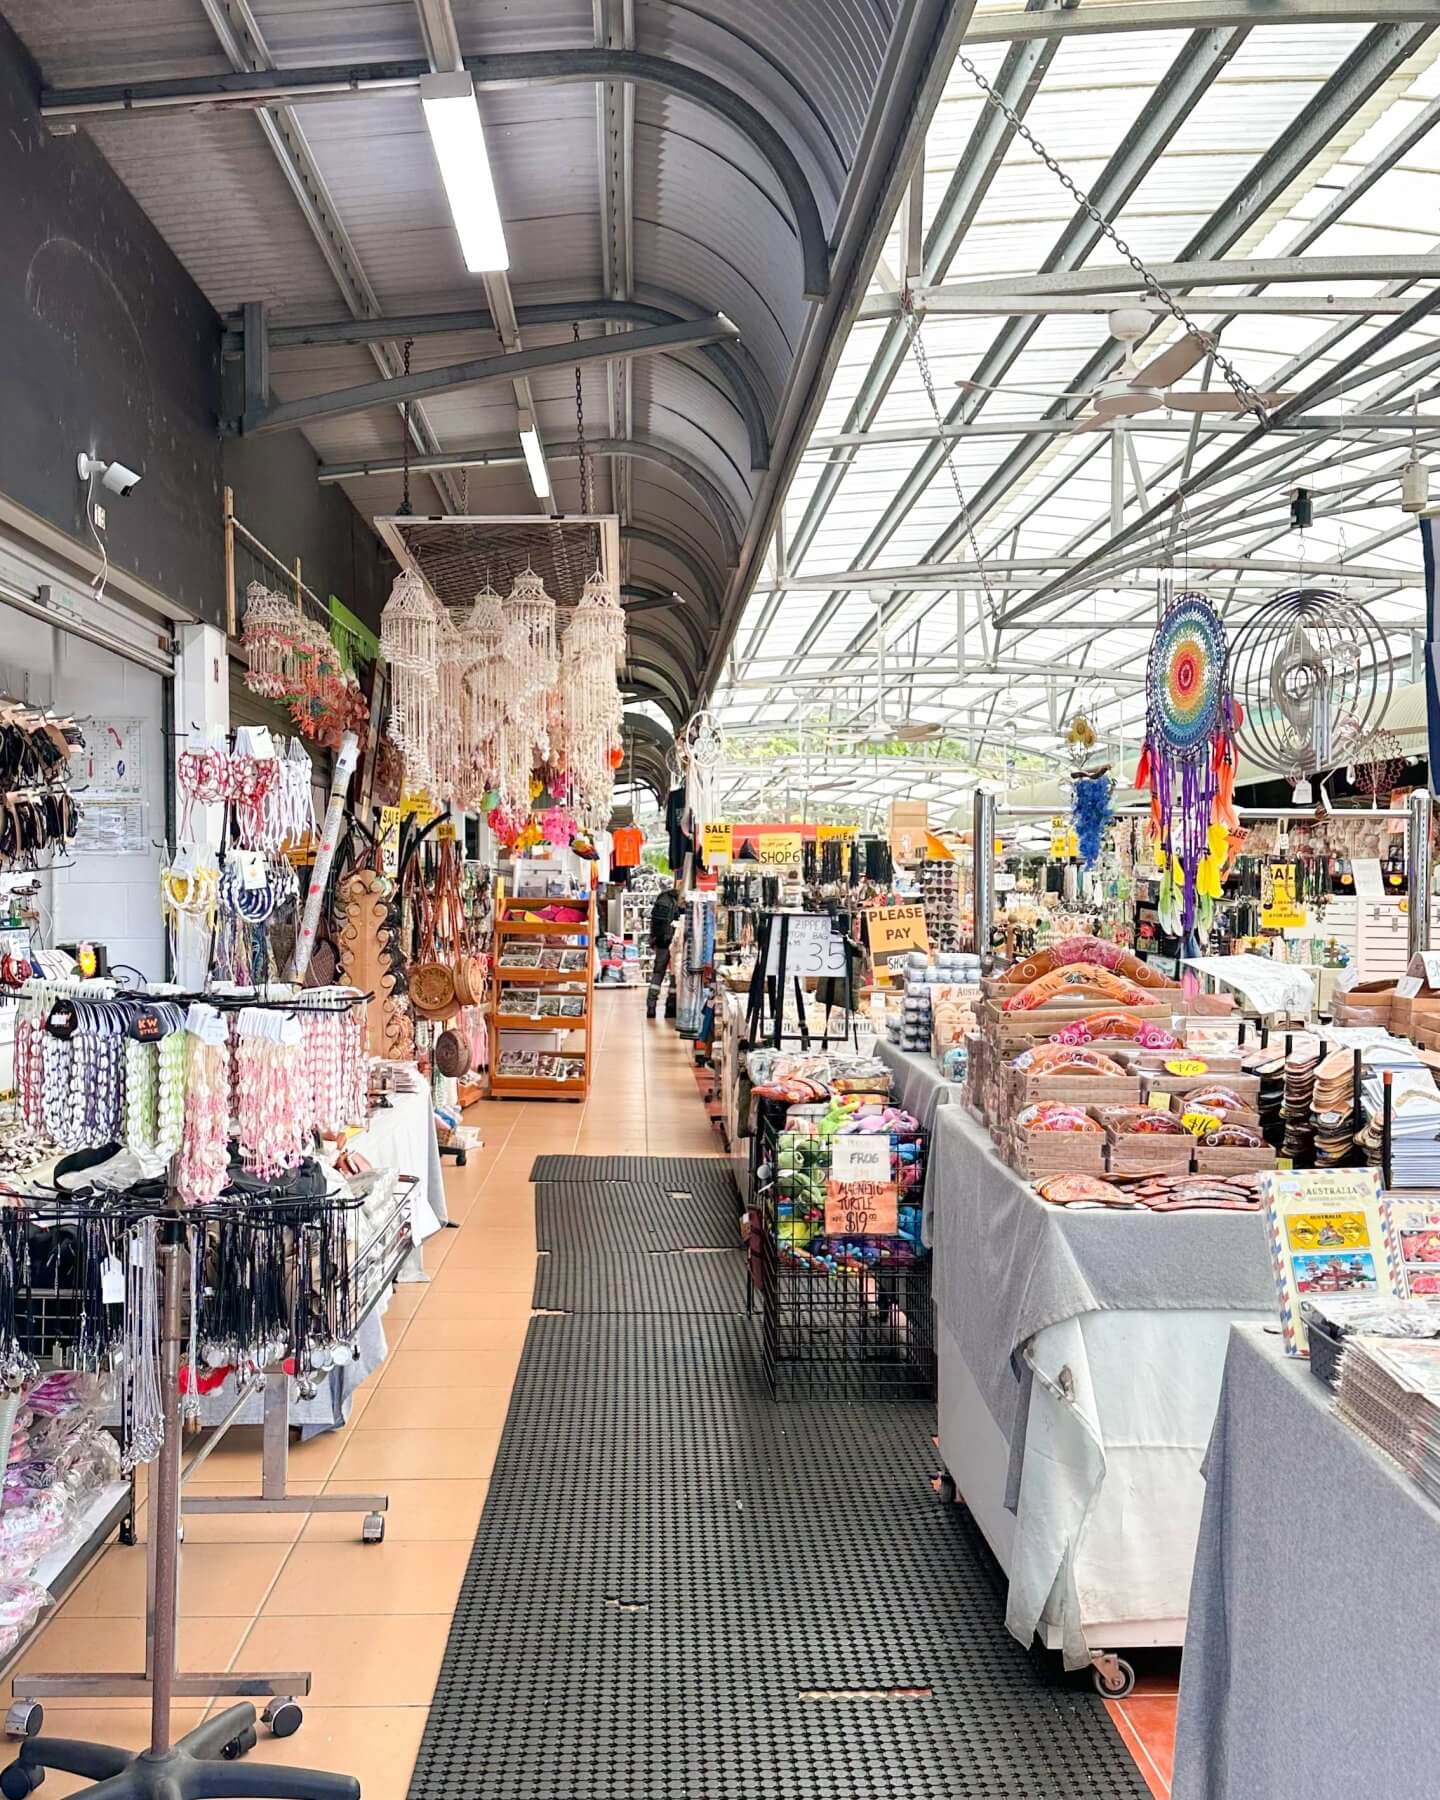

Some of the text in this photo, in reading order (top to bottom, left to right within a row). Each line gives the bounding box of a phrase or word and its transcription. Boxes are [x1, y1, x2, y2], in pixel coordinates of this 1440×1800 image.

[382, 809, 399, 824] SALE
[704, 824, 731, 834] SALE
[868, 907, 923, 922] PLEASE
[886, 927, 911, 940] PAY
[849, 1152, 880, 1164] FROG
[1306, 1186, 1358, 1195] AUSTRALIA
[837, 1197, 876, 1210] TURTLE
